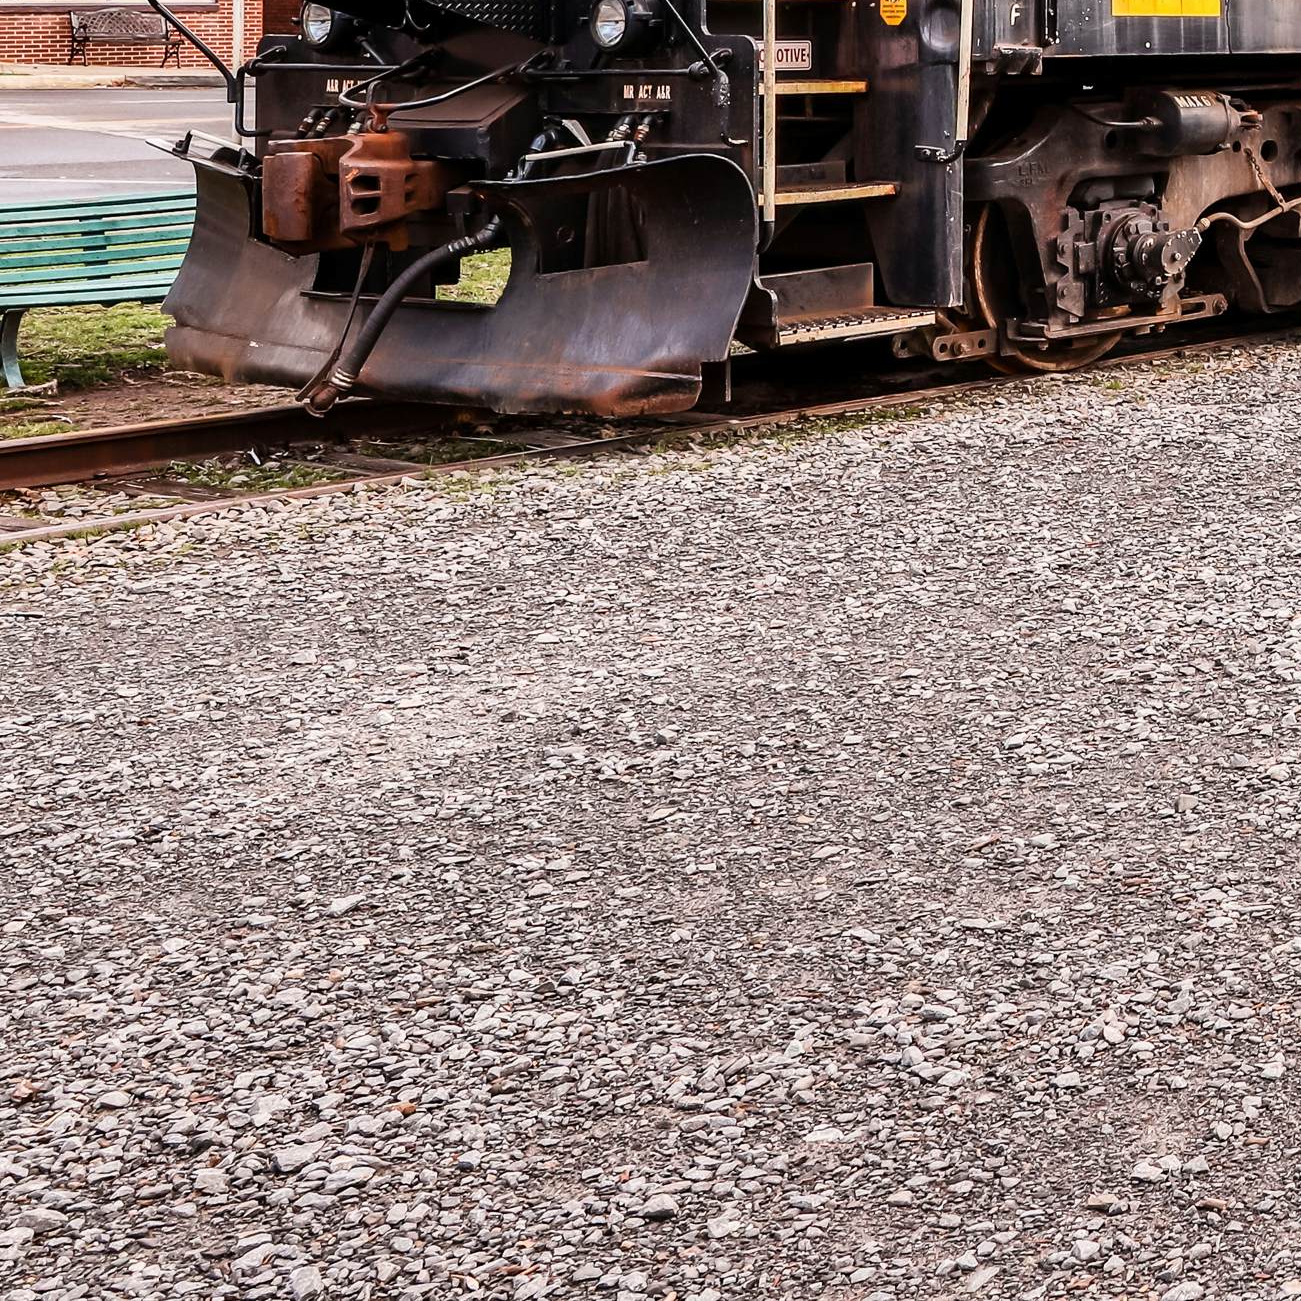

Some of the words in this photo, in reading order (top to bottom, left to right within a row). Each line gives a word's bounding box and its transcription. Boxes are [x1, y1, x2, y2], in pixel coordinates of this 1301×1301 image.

[624, 84, 634, 99] MR
[638, 84, 653, 99] ACT
[656, 85, 671, 100] A&R
[1173, 95, 1203, 108] MAX
